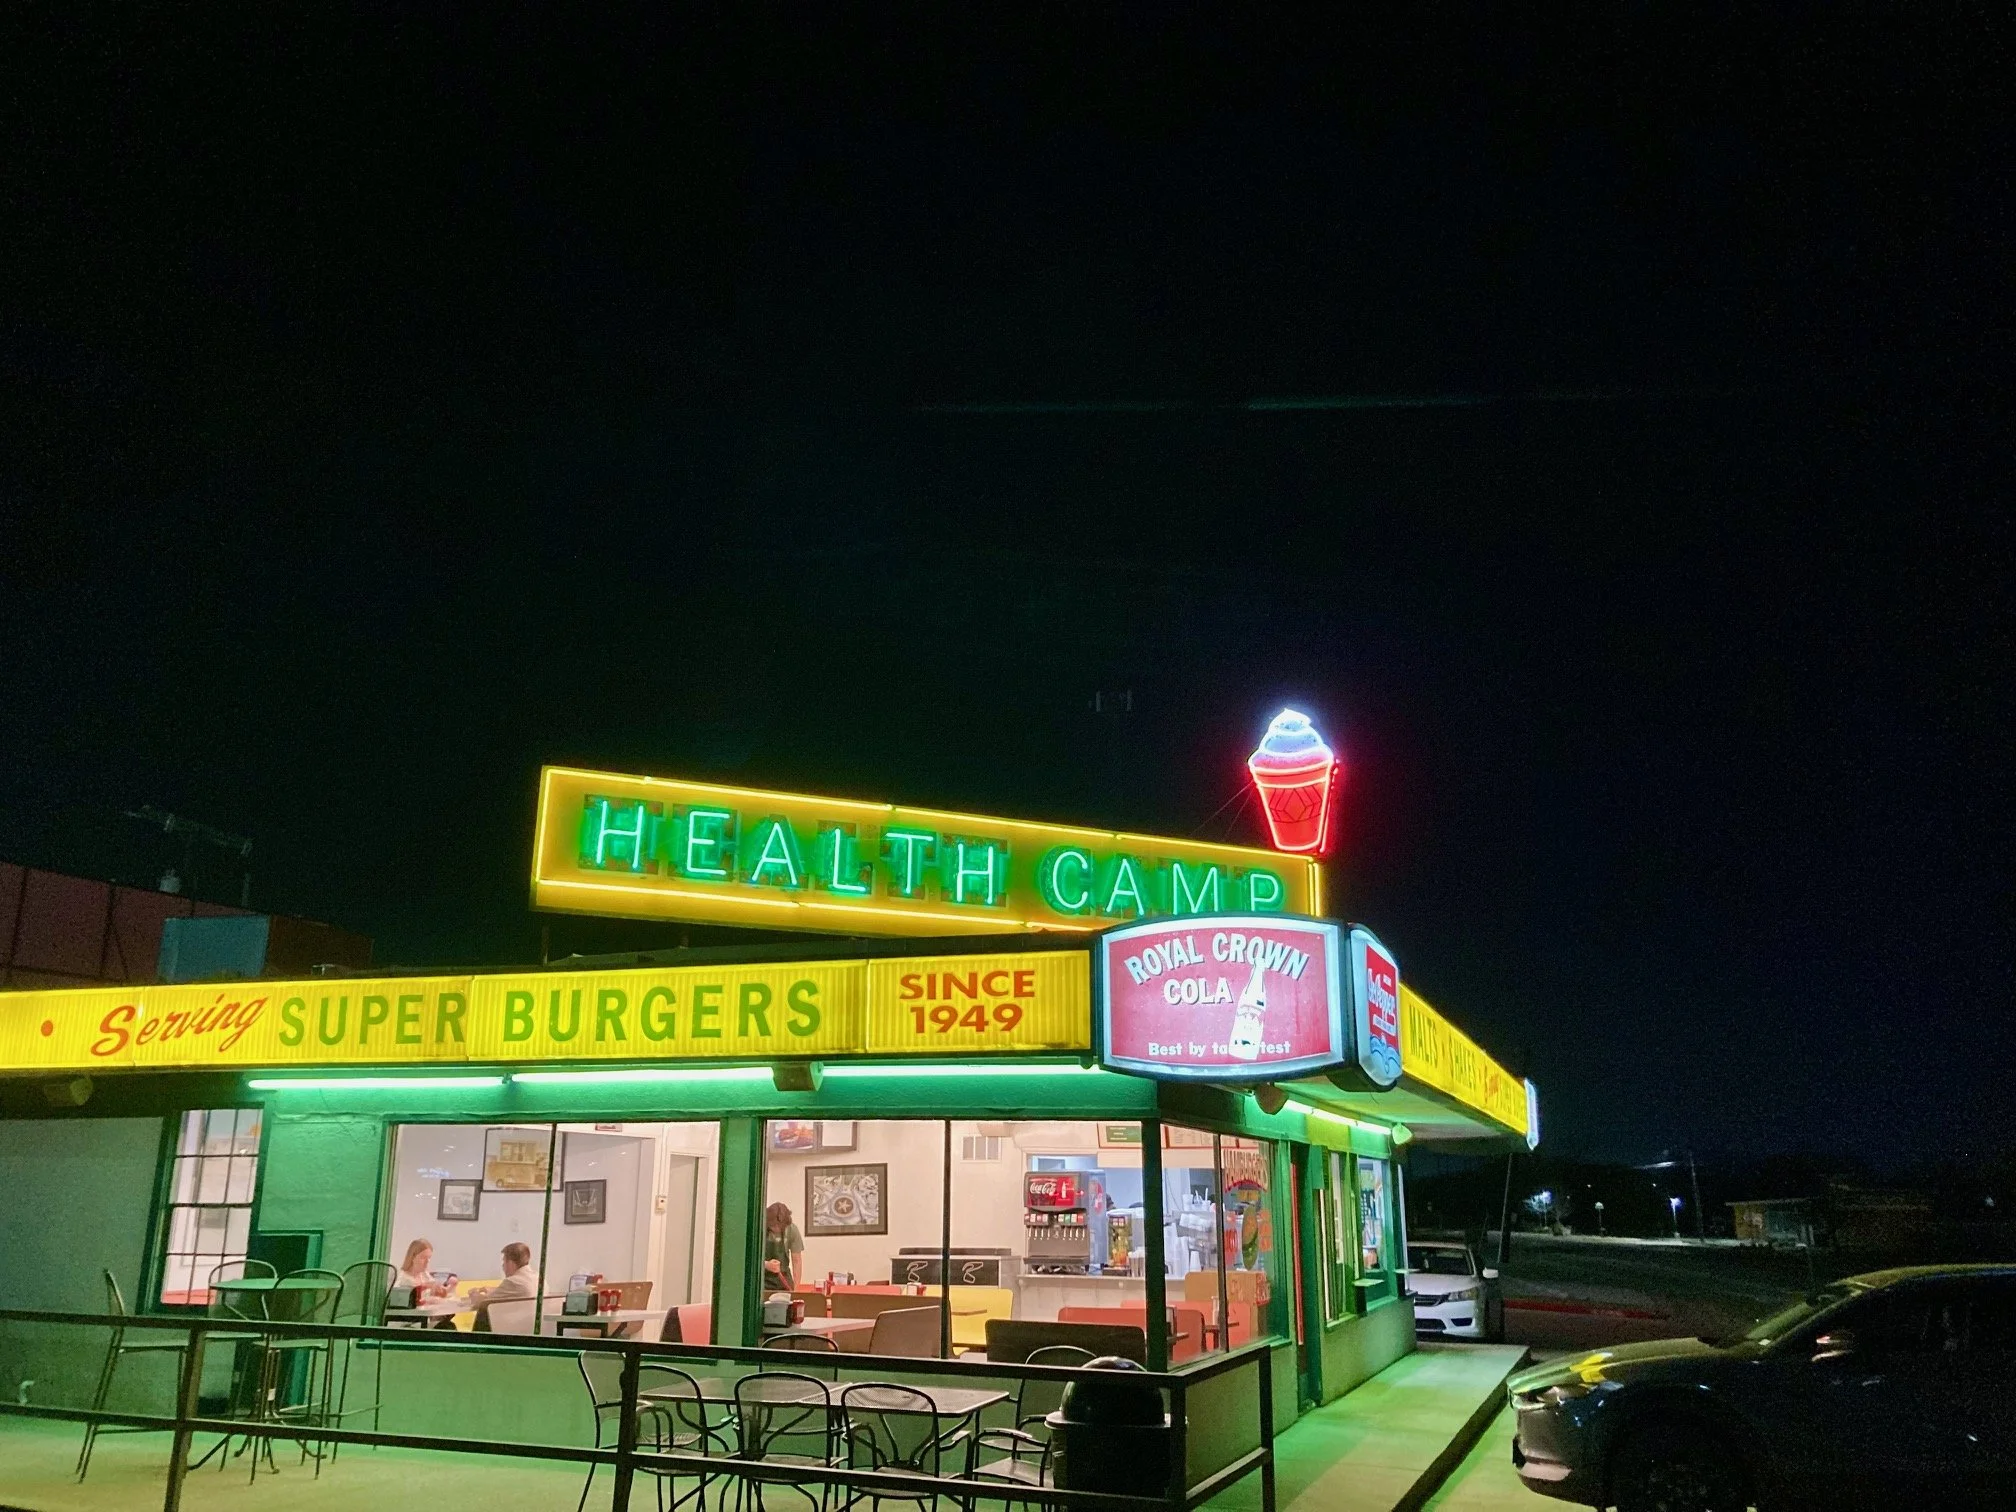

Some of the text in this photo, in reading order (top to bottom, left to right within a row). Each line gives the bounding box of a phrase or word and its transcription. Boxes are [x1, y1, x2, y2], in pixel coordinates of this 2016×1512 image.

[591, 799, 1281, 915] HEALTH CAMP
[1123, 932, 1310, 985] ROYAL CROWN
[899, 970, 1036, 1000] SINCE
[1163, 976, 1233, 1005] COLA
[90, 979, 822, 1056] Serving SUPER BURGERS
[909, 1003, 1024, 1034] 1949
[1408, 1003, 1438, 1069] MALTS
[1148, 1042, 1183, 1056] Best
[1188, 1041, 1206, 1057] by
